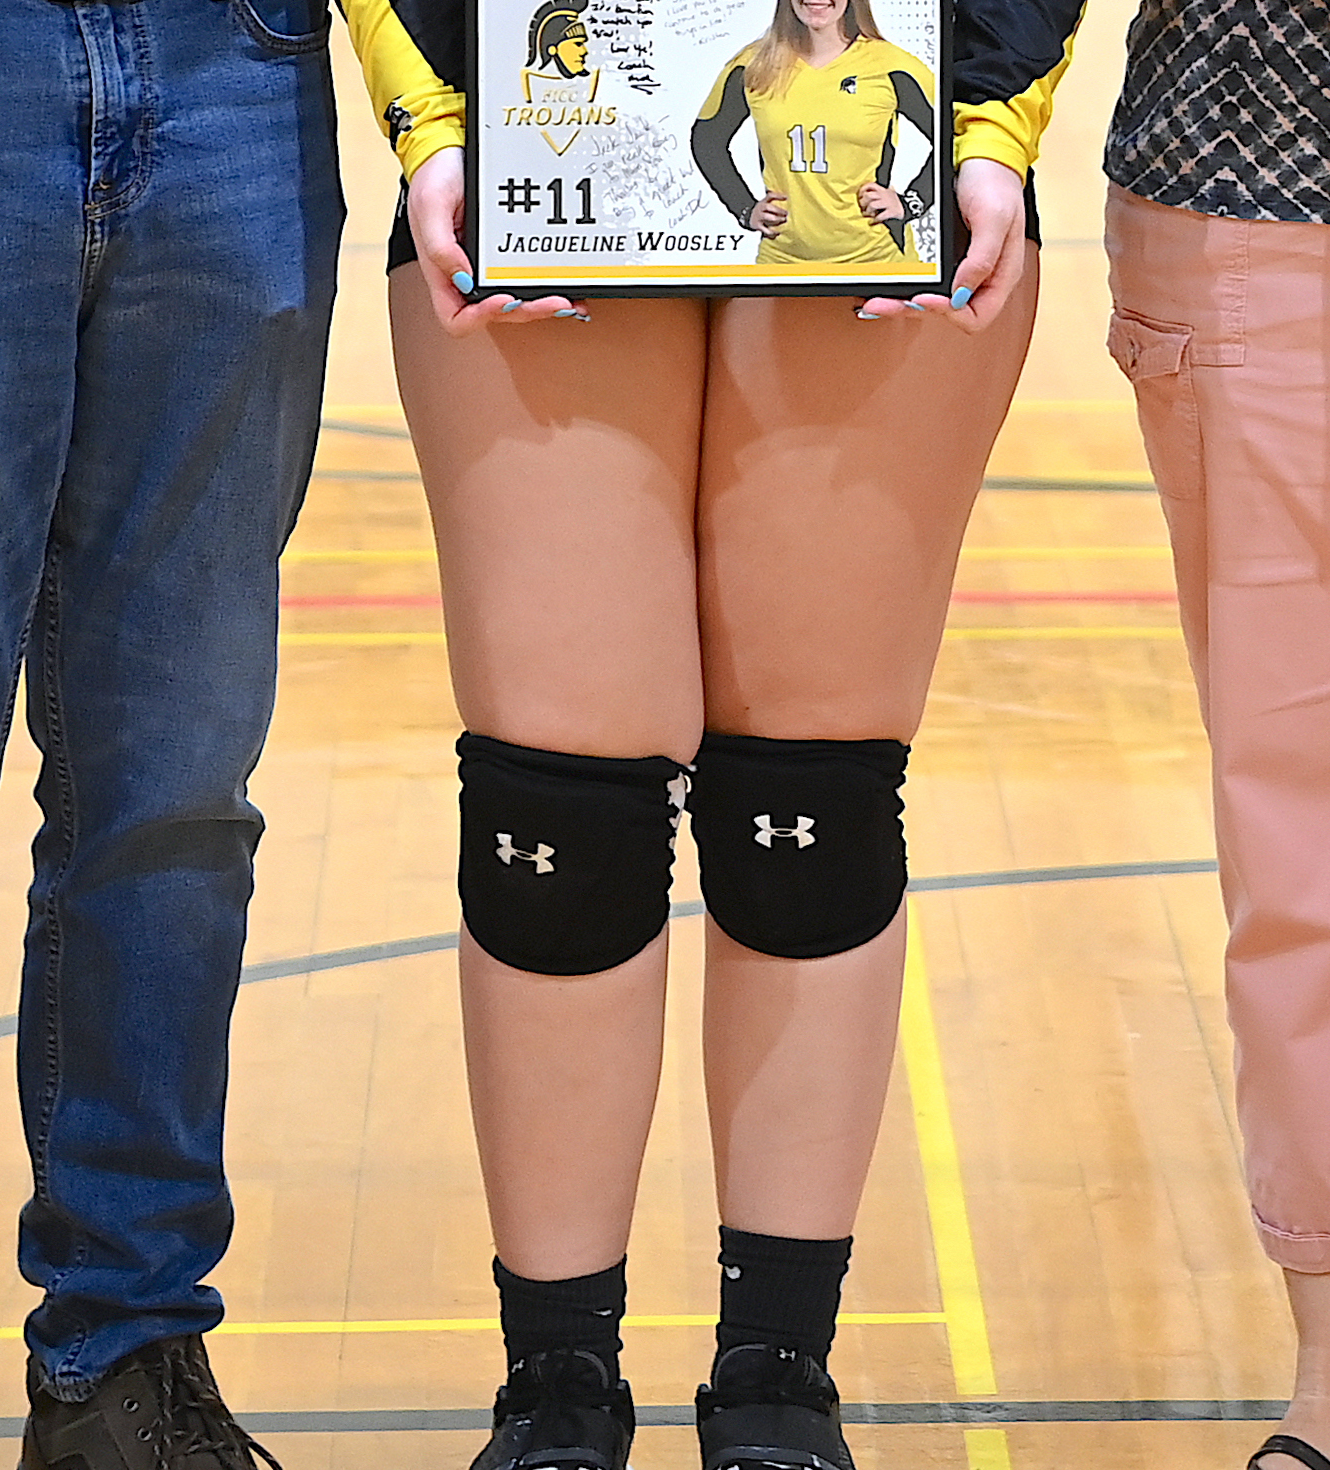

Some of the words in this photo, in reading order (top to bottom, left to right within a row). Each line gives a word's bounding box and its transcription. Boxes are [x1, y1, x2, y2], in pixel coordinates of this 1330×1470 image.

[502, 106, 617, 126] TROJANS
[787, 124, 828, 173] 11
[498, 178, 596, 224] #11
